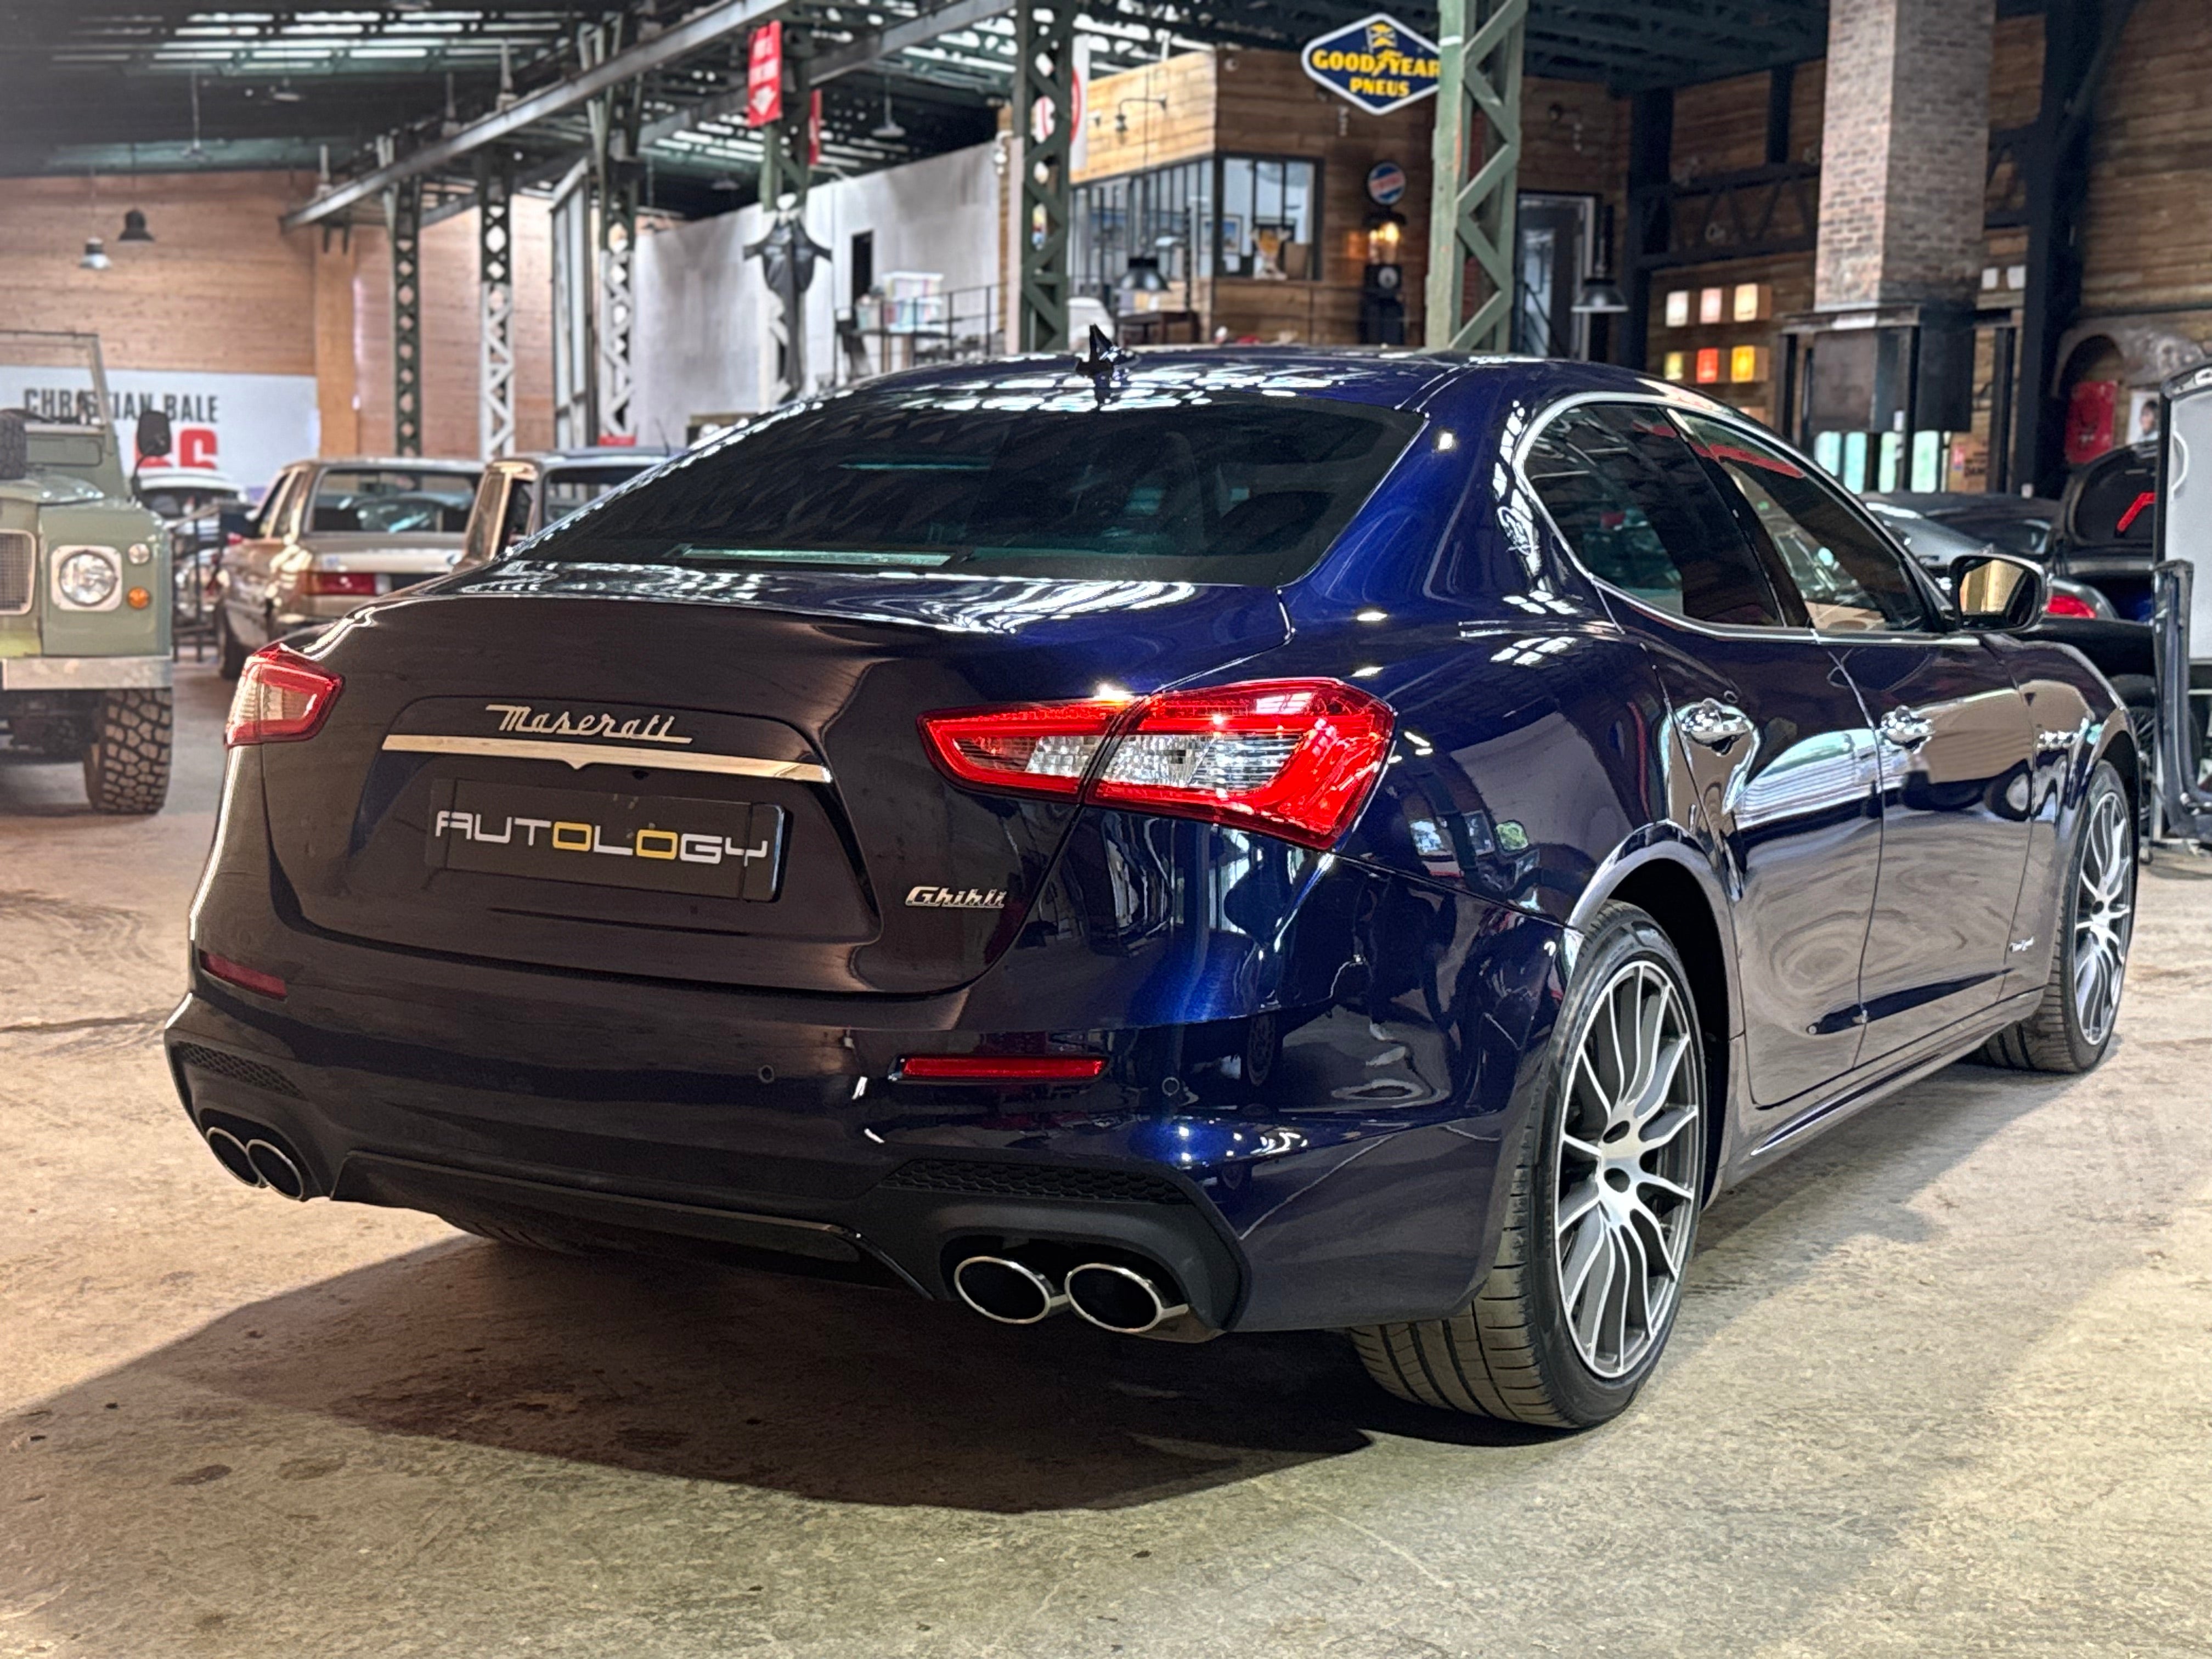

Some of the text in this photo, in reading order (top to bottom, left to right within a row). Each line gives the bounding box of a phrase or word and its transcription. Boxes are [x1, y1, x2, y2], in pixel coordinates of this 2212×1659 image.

[1350, 78, 1409, 97] PNEUS
[163, 394, 218, 422] BALE
[486, 704, 693, 744] Maserati
[435, 810, 769, 867] AUTOLOGY
[905, 886, 1007, 909] Ghibli
